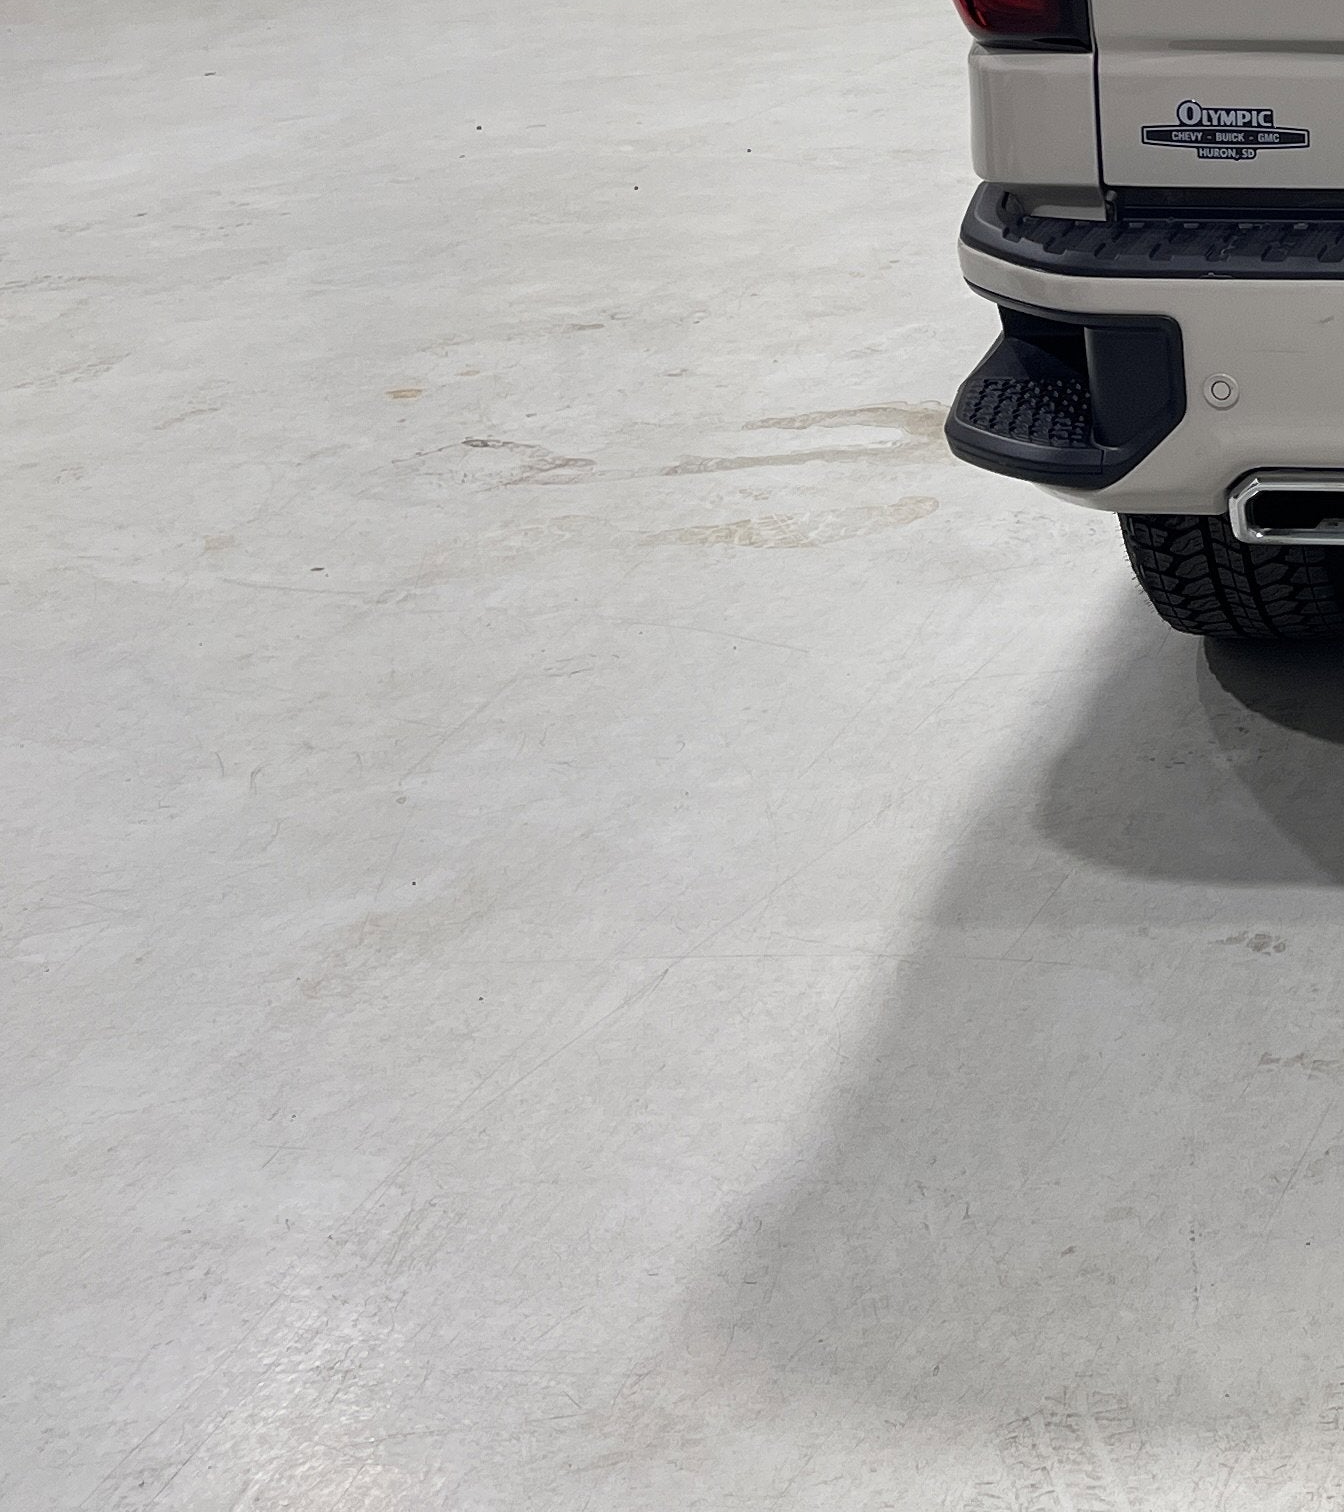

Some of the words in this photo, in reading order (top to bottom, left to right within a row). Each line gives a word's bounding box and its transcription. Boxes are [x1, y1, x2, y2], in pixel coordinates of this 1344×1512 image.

[1171, 131, 1203, 141] CHEVY
[1215, 132, 1245, 142] BUICK
[1257, 133, 1280, 143] GMC
[1199, 148, 1239, 159] HURON,
[1242, 148, 1255, 158] SD
